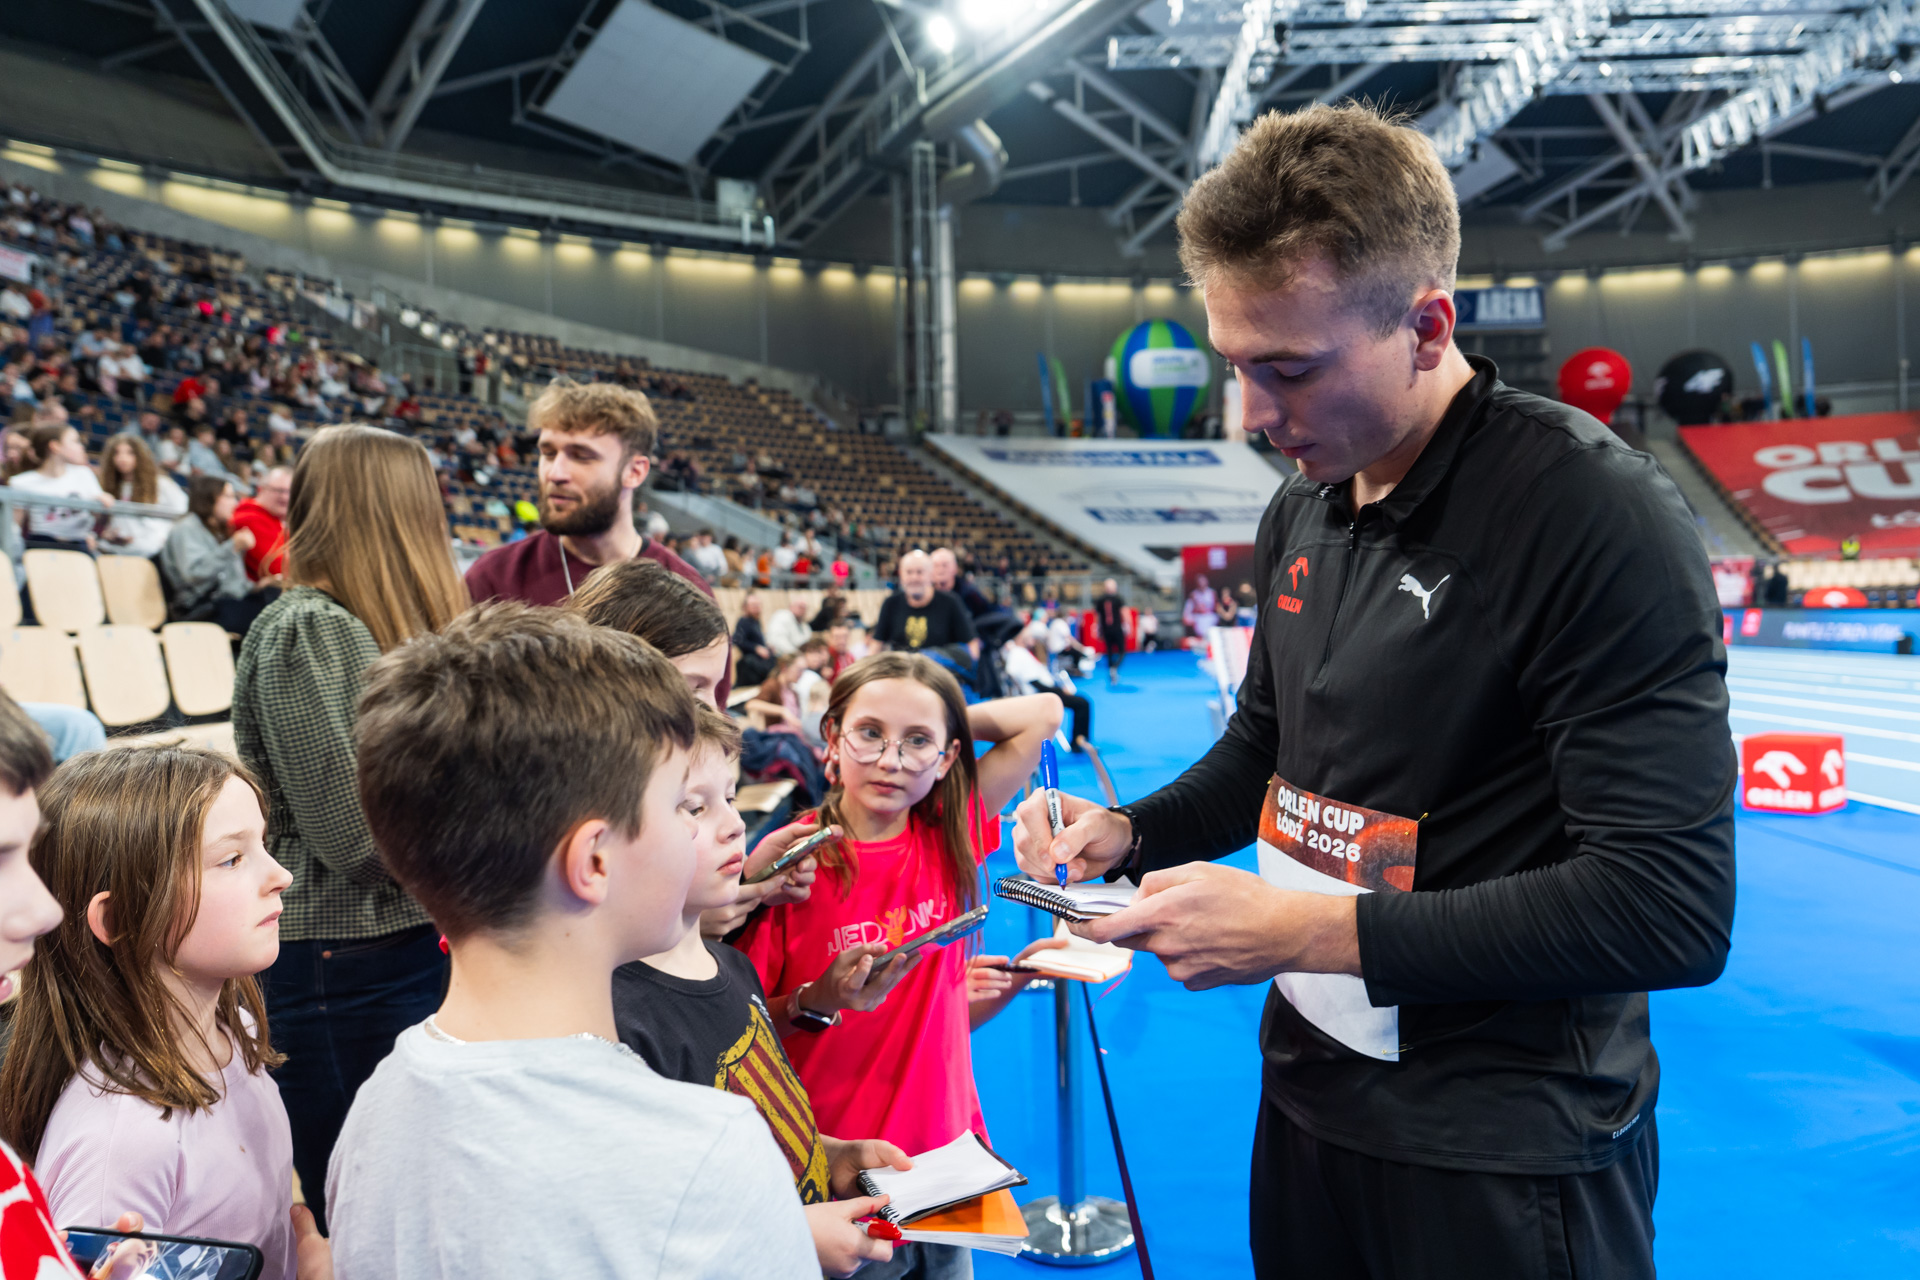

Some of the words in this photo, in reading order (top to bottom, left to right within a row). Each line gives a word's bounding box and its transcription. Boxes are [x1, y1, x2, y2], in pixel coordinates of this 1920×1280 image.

[1476, 288, 1543, 322] ARENA
[1753, 436, 1920, 468] ORL
[1277, 594, 1303, 614] ORLEN
[1277, 785, 1321, 824] ORLEN
[1322, 805, 1365, 835] CUP
[1746, 787, 1813, 810] ORLEN
[1276, 811, 1305, 843] ŁÓDŹ
[1307, 829, 1362, 863] 2026
